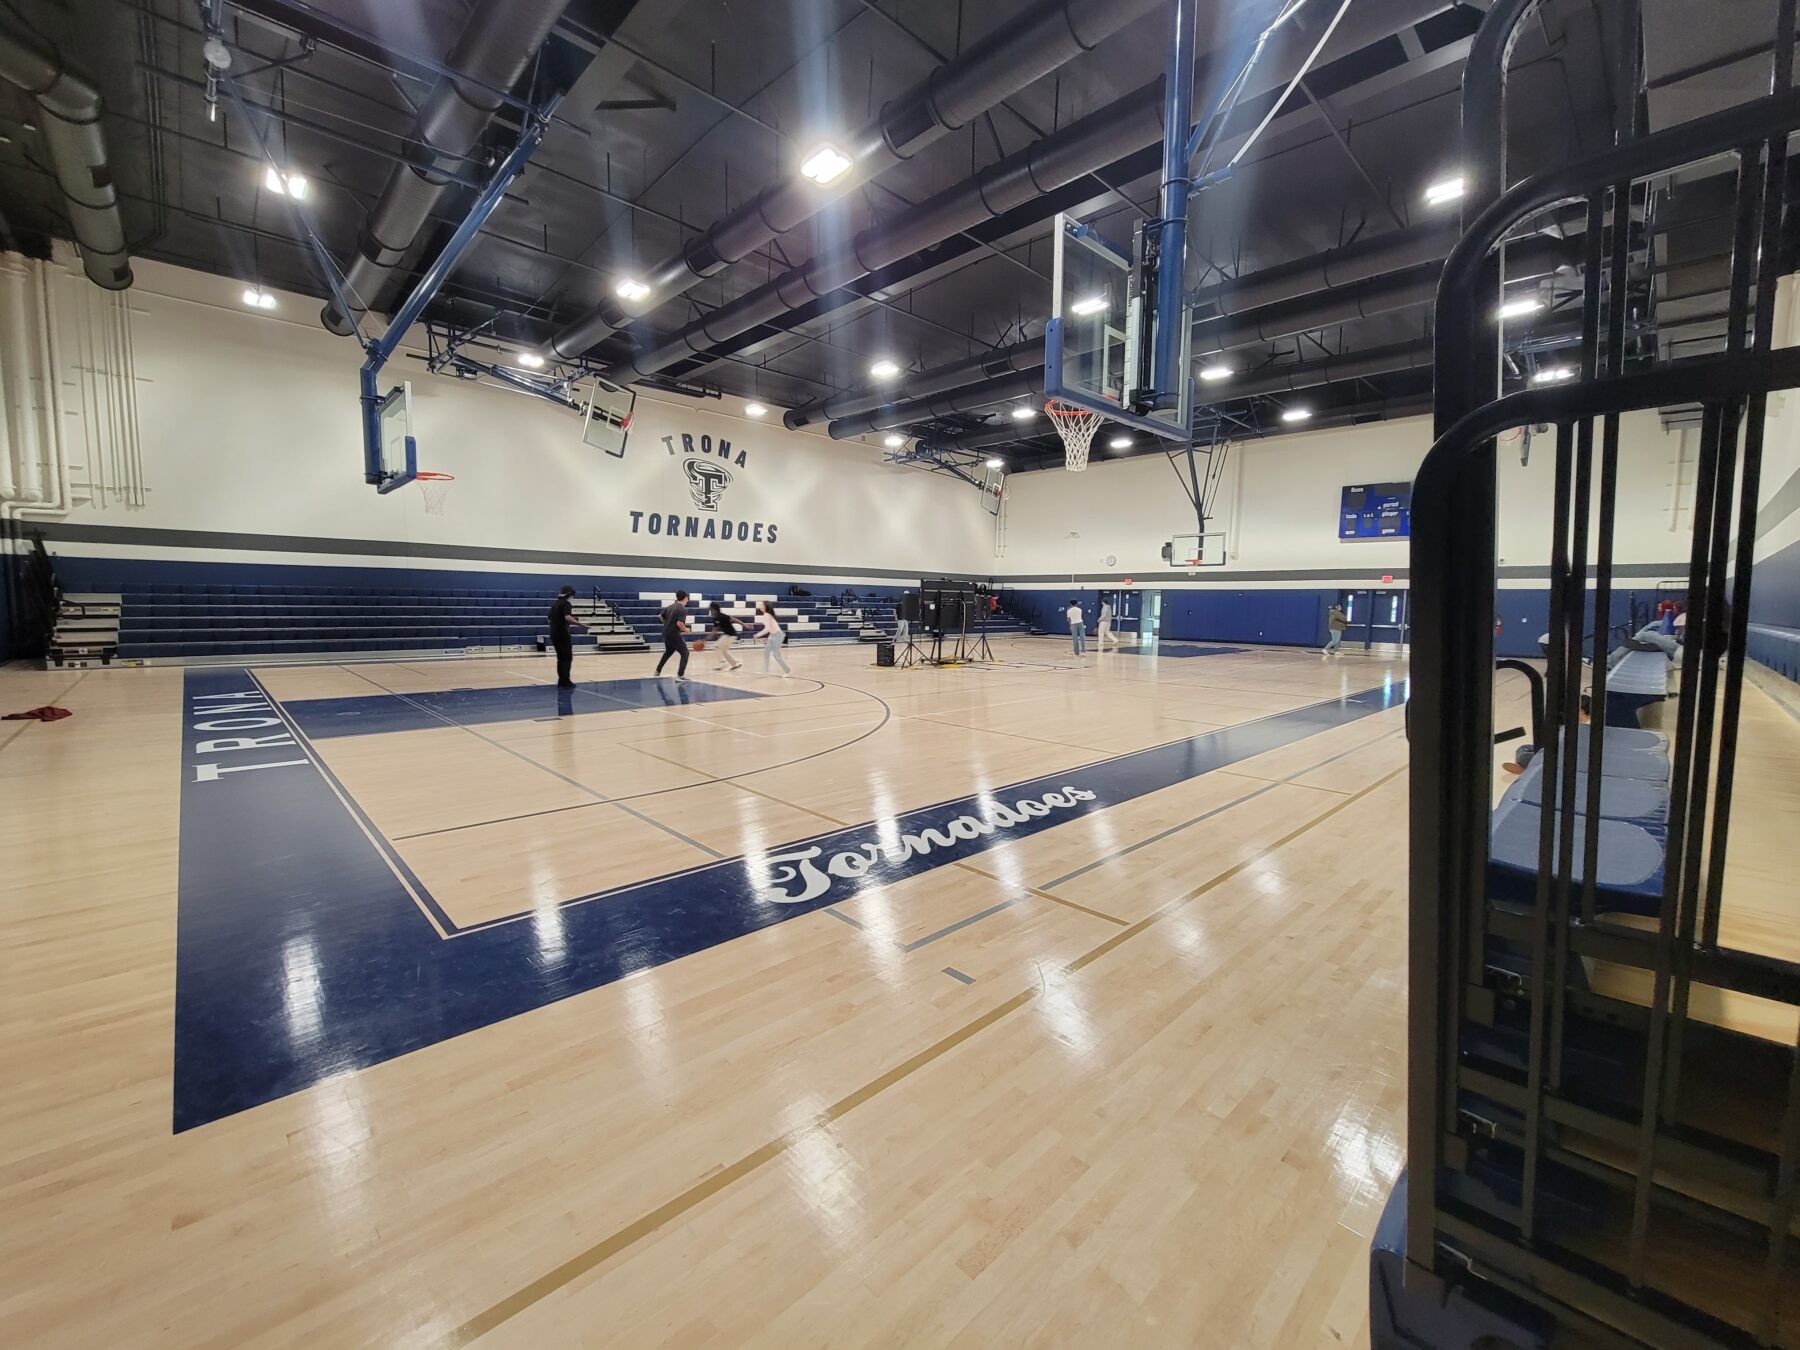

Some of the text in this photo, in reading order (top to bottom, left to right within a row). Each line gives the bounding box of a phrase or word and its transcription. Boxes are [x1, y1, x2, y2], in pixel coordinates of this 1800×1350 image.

[661, 433, 748, 469] TRONA
[629, 510, 778, 544] TORNADOES
[192, 690, 310, 783] TRONA
[764, 785, 1097, 904] Tornadoes
